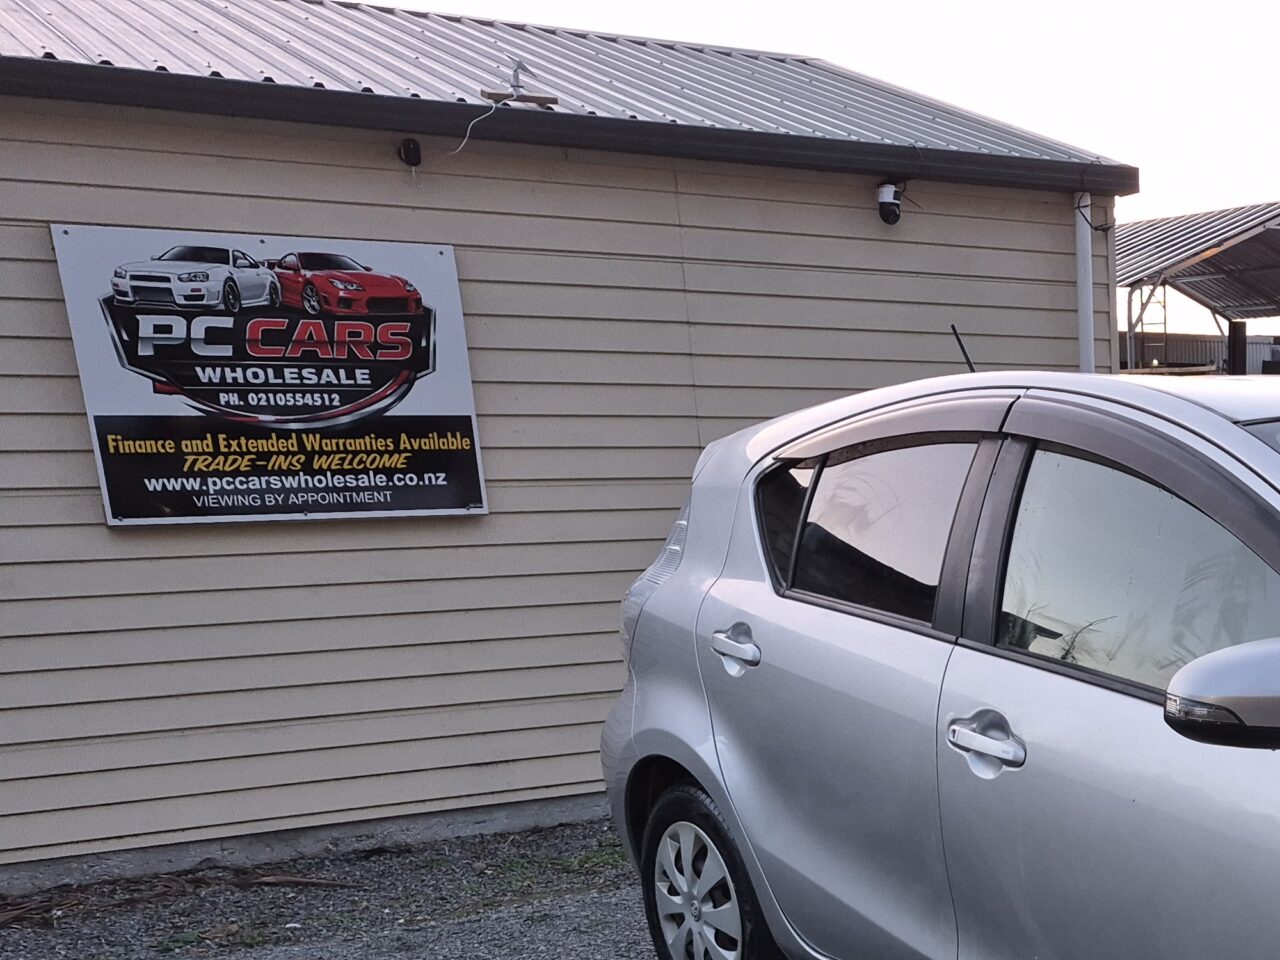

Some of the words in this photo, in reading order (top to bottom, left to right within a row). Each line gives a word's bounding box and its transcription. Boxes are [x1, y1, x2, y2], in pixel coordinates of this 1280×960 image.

[135, 314, 234, 356] PC
[246, 318, 413, 360] CARS
[194, 366, 372, 385] WHOLESALE
[219, 392, 244, 406] PH.
[247, 392, 341, 407] 0210554512
[107, 434, 176, 453] Finance
[181, 432, 214, 452] and
[218, 432, 298, 452] Extended
[302, 433, 395, 451] Warranties
[400, 431, 471, 450] Available
[182, 454, 305, 472] TRADE-INS
[312, 453, 412, 470] WELCOME
[144, 470, 448, 494] www.pccarswholesale.co.nz
[193, 494, 261, 508] VIEWING
[264, 493, 285, 506] BY
[288, 490, 393, 505] APPOINTMENT
